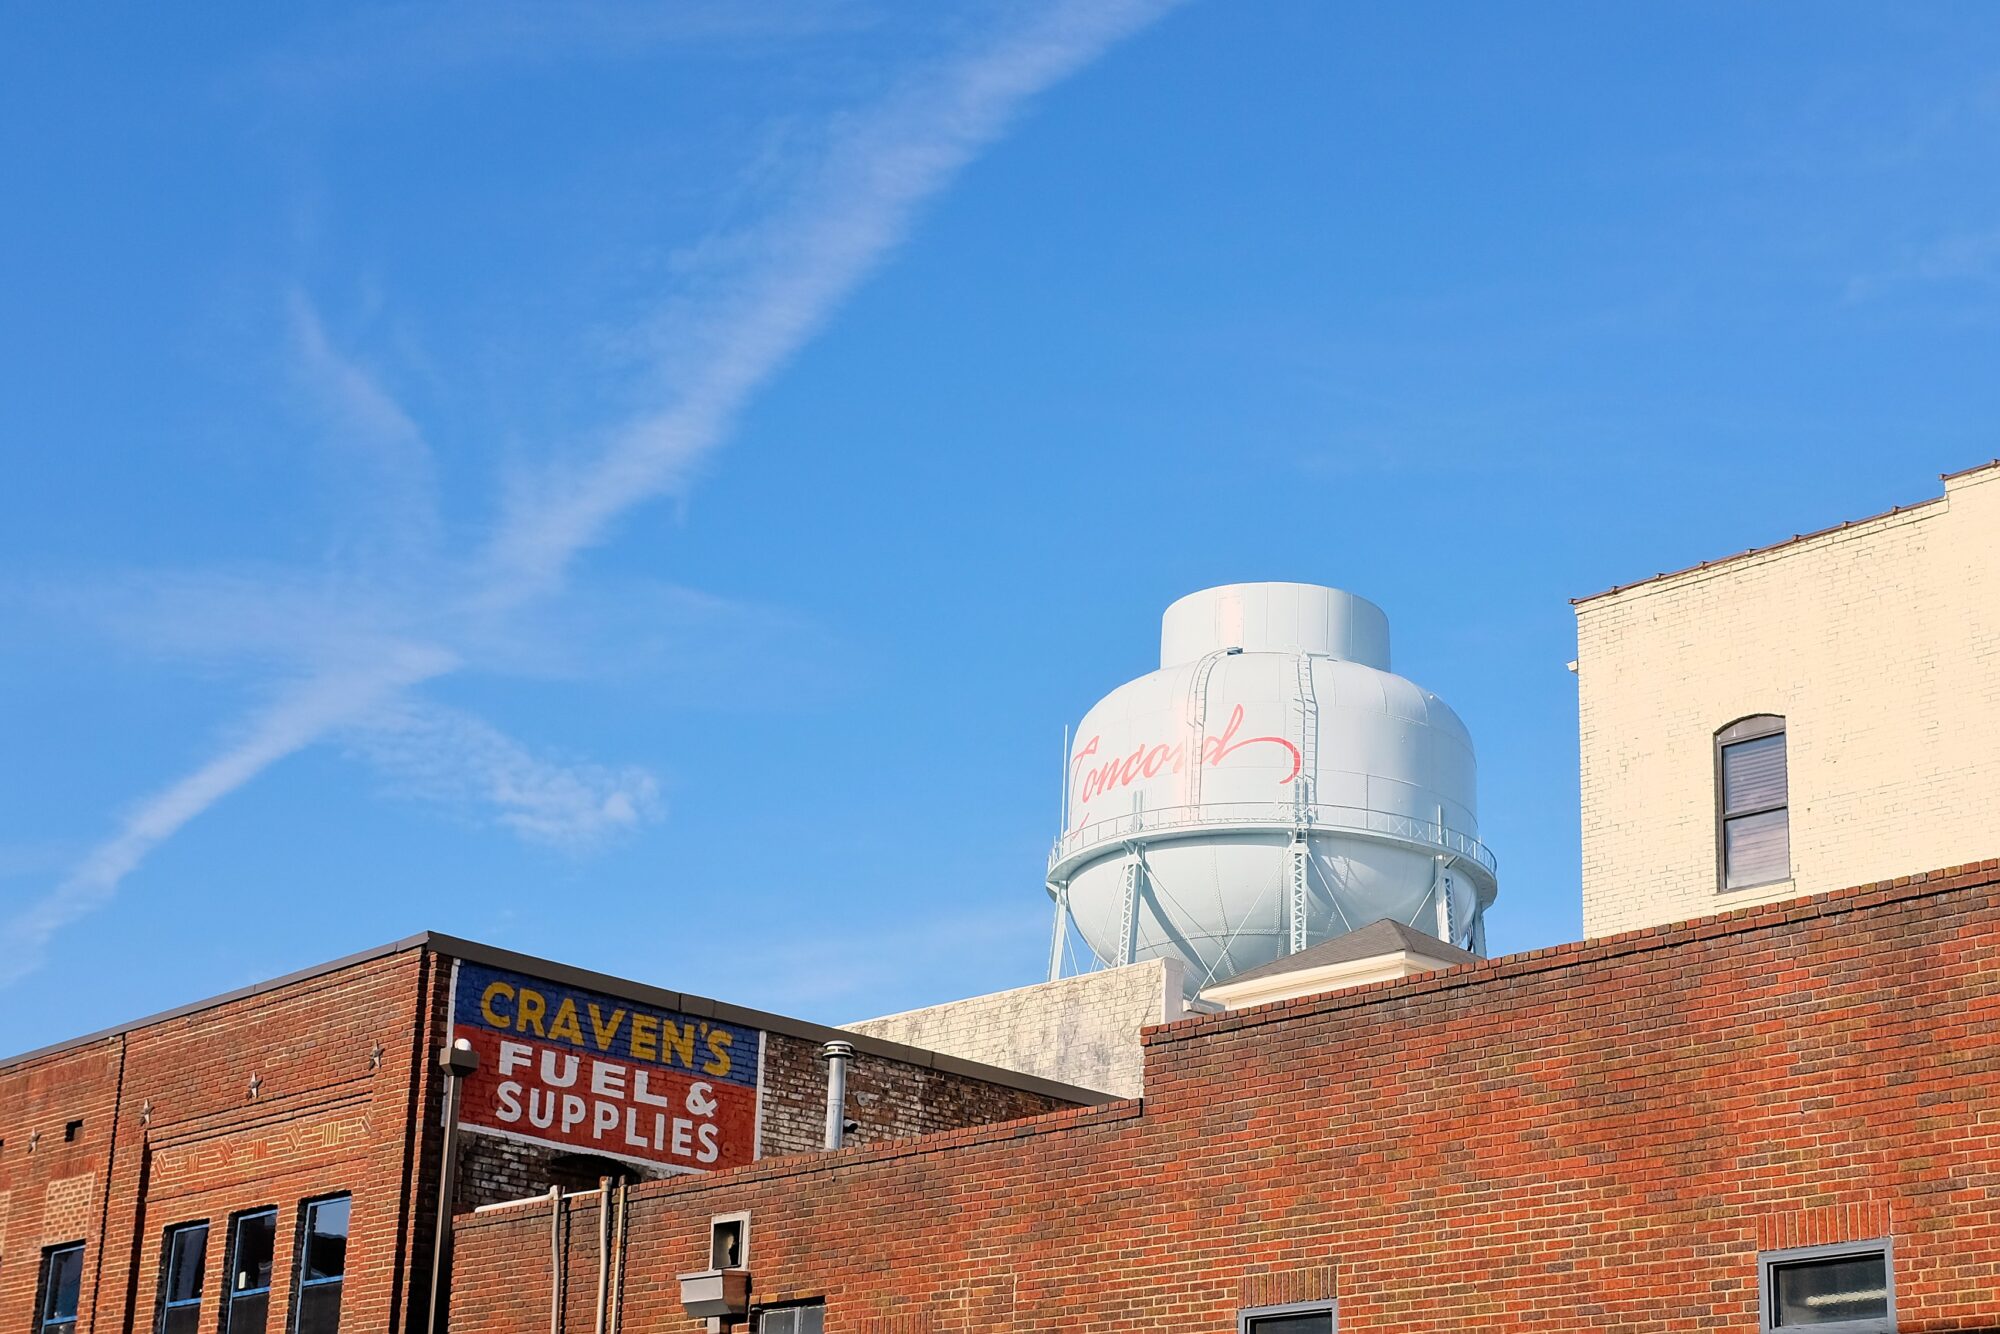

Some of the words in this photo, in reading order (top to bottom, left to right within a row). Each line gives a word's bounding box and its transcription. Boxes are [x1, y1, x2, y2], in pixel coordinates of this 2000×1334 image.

[481, 982, 732, 1076] CRAVEN'S
[499, 1040, 668, 1107] FUEL
[686, 1082, 717, 1117] &
[496, 1081, 719, 1162] SUPPLIES
